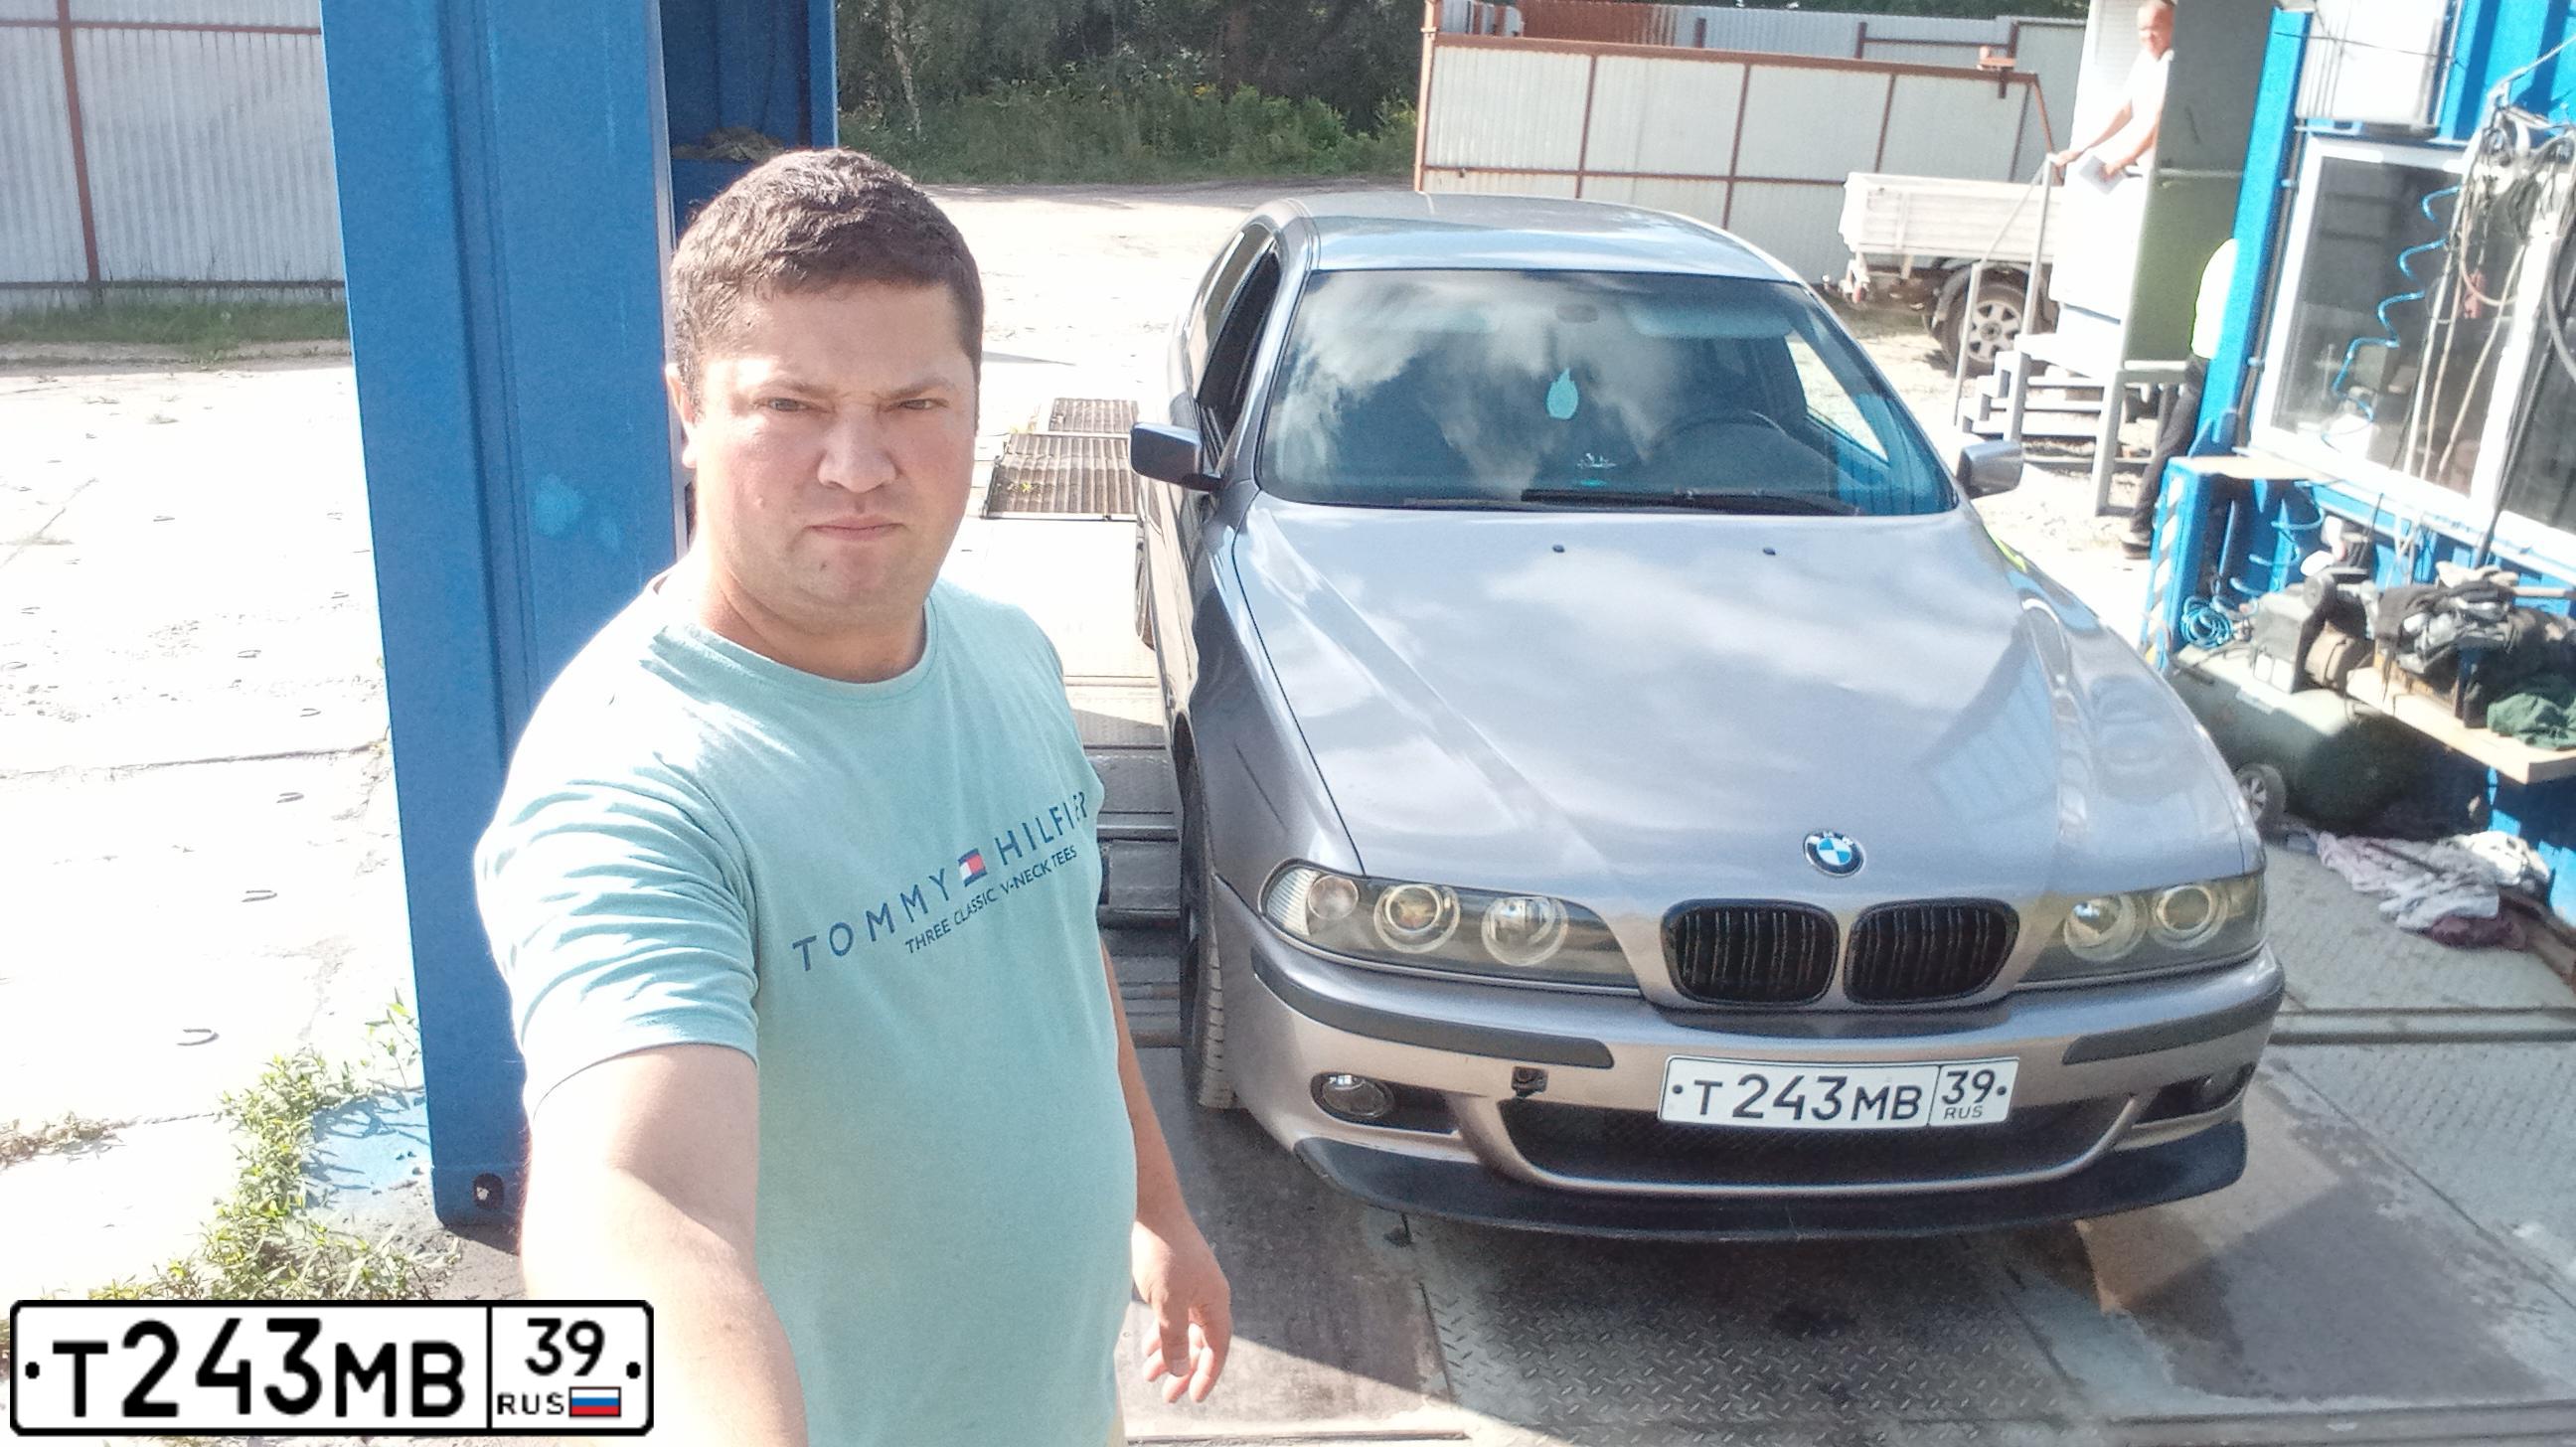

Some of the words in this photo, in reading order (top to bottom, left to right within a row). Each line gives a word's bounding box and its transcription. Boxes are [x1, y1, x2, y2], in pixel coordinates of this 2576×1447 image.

[792, 868, 950, 972] TOMMY
[904, 918, 951, 954] THREE
[953, 887, 998, 926] CLASSIC
[1000, 859, 1051, 894] V-NECK
[1050, 845, 1077, 867] TEES
[1941, 1068, 1996, 1105] 39
[1944, 1104, 1984, 1120] RUS
